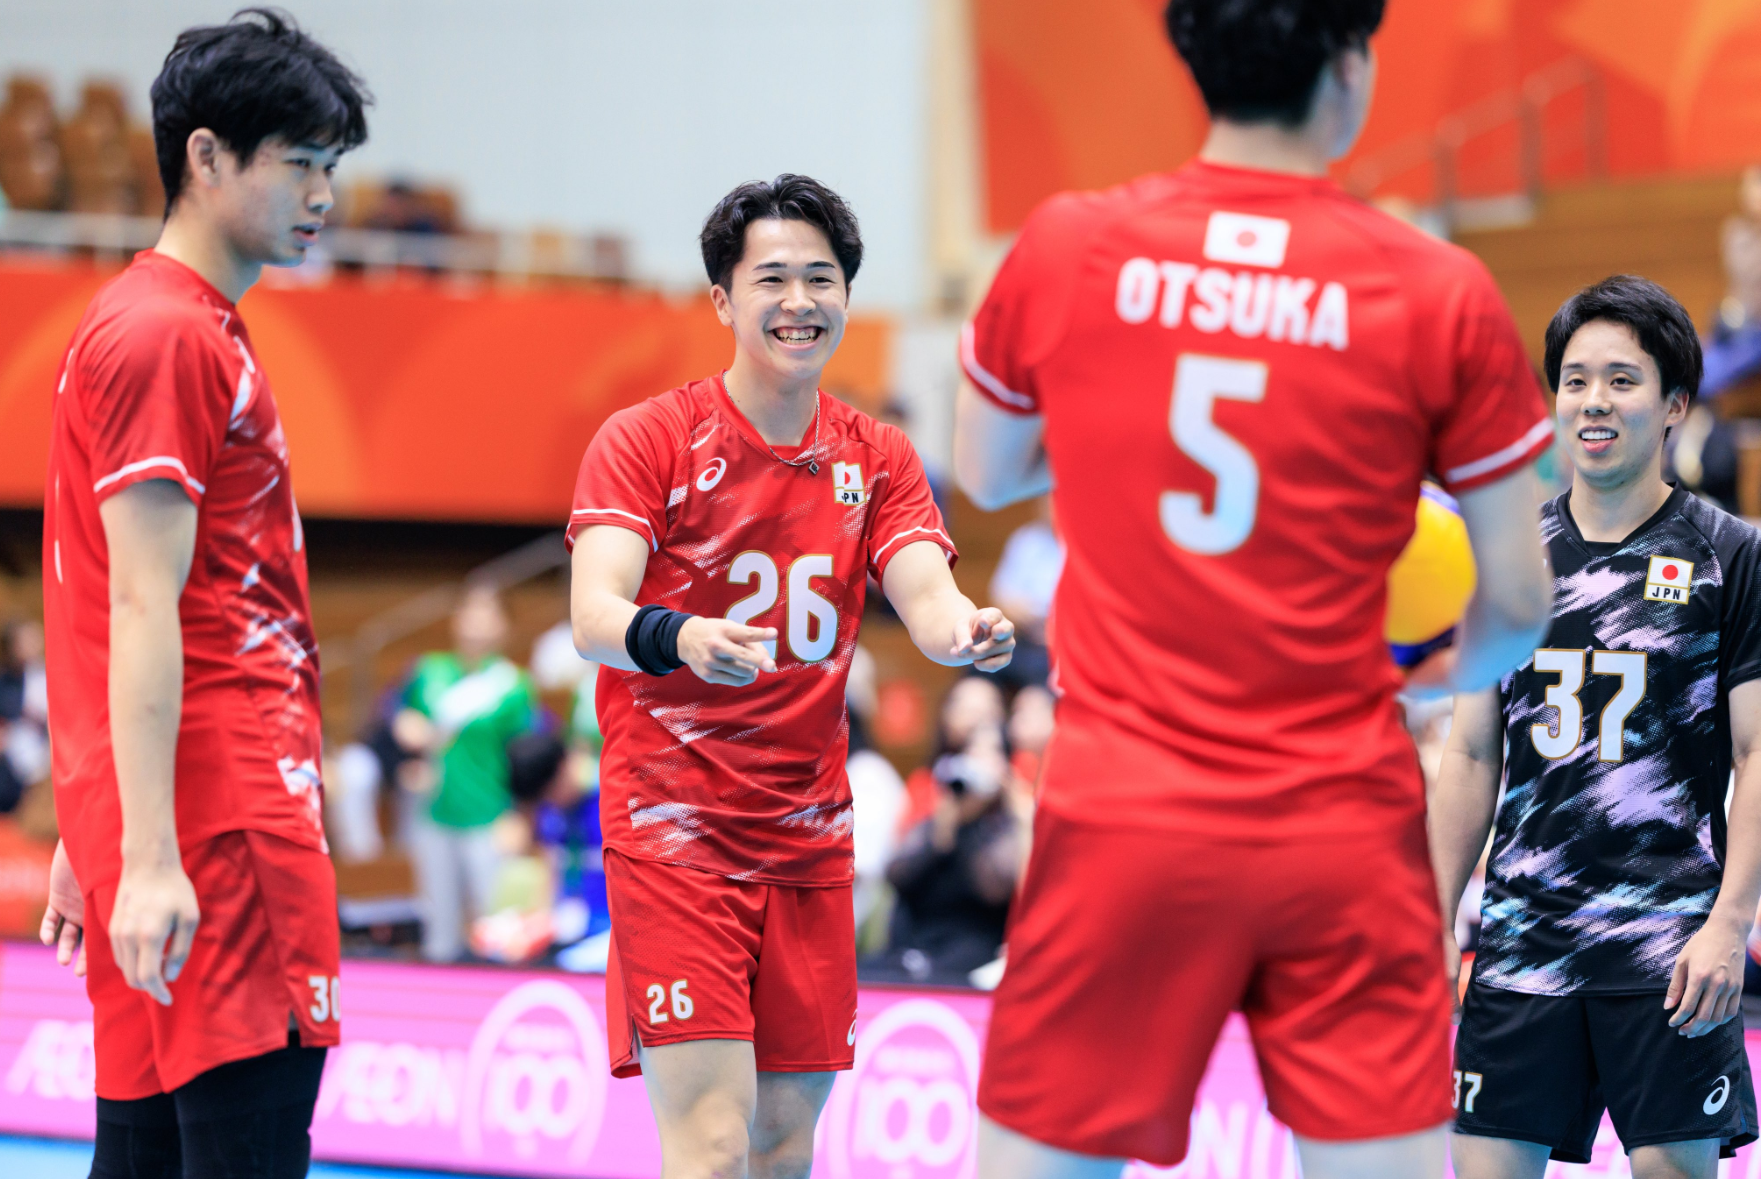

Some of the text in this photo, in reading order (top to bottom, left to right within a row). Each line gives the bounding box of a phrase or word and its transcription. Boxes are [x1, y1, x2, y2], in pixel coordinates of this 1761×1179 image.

[1115, 257, 1350, 351] OTSUKA
[1158, 352, 1269, 557] 5
[724, 549, 839, 663] 26
[1651, 586, 1681, 600] JPN
[1530, 648, 1648, 763] 37
[646, 978, 694, 1025] 26
[1451, 1069, 1483, 1113] 37
